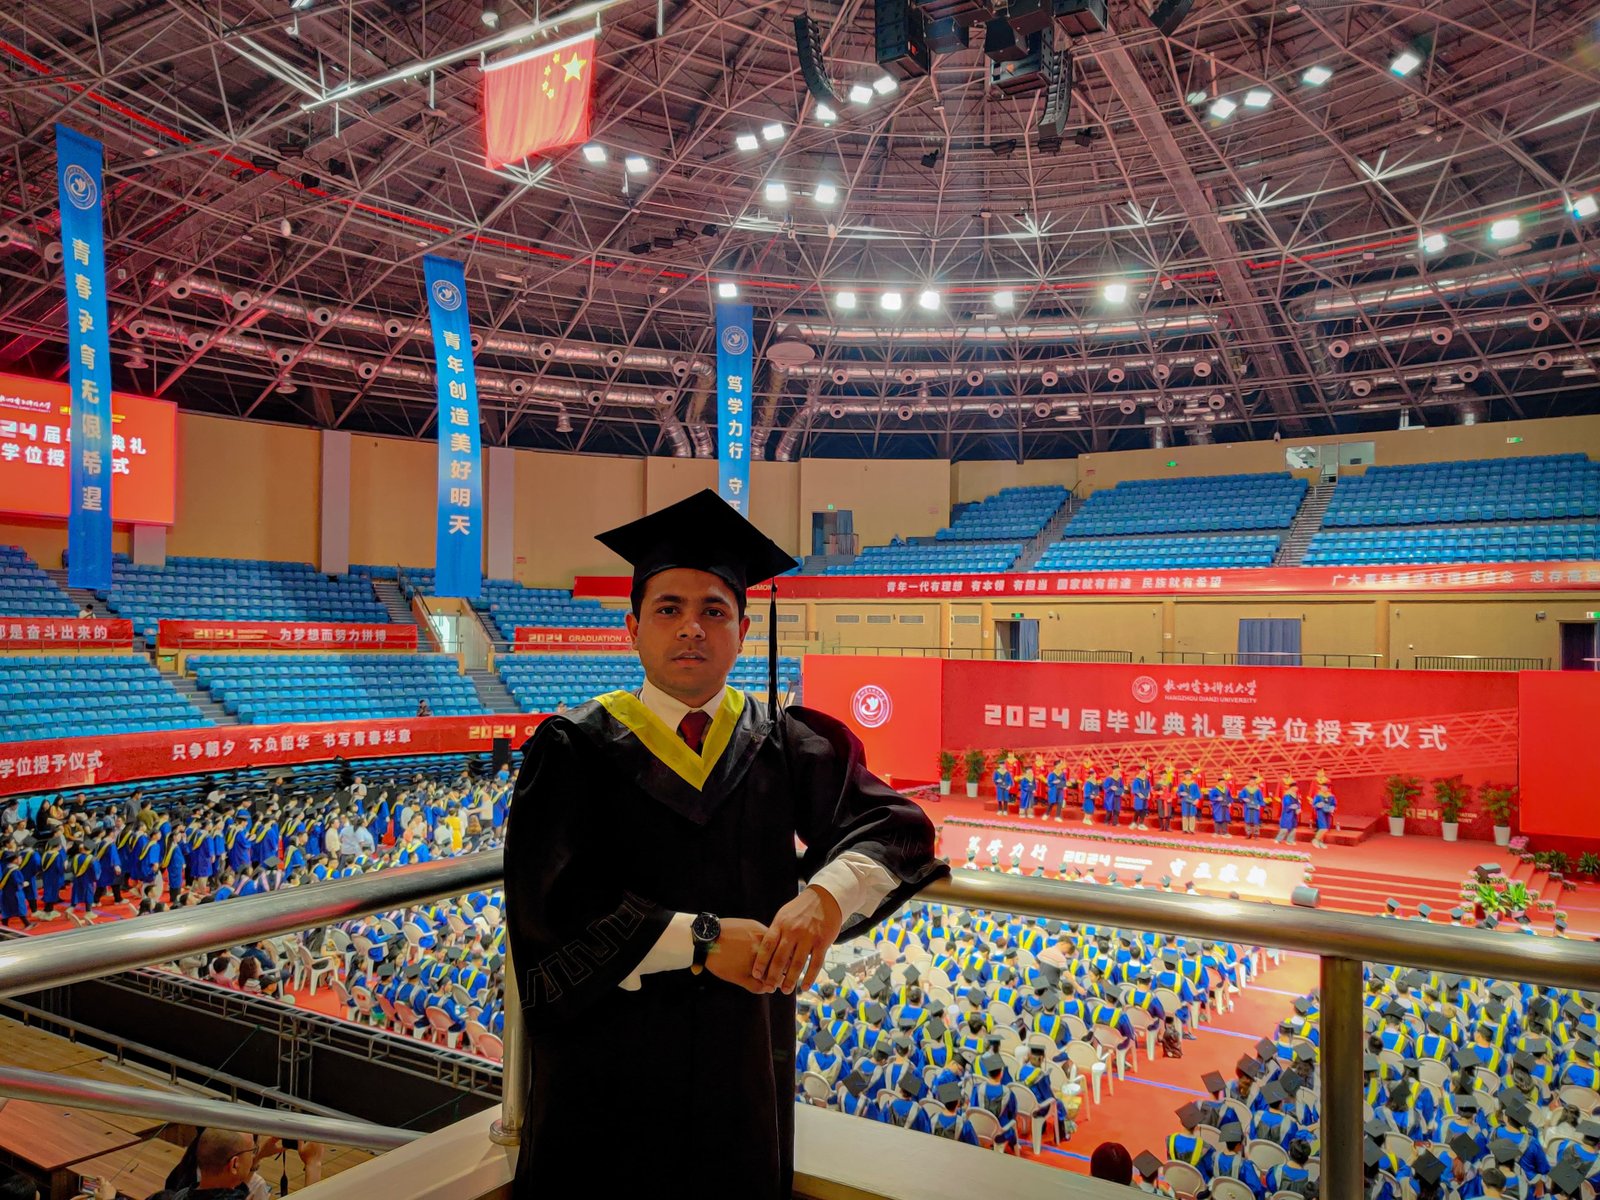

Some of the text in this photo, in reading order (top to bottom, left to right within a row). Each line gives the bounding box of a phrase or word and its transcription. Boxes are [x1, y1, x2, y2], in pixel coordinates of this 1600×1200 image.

[443, 330, 472, 536] 青年创造美好明天
[727, 375, 743, 460] 笃学力行
[528, 633, 562, 643] 2024
[568, 635, 622, 643] GRADUATION
[469, 725, 516, 739] 2024
[984, 704, 1447, 751] 2024届毕业典礼暨学位授予仪式
[0, 729, 412, 779] 学位授予仪式 只争朝夕 不负韶华 书写青春华章
[1063, 850, 1111, 867] 2024
